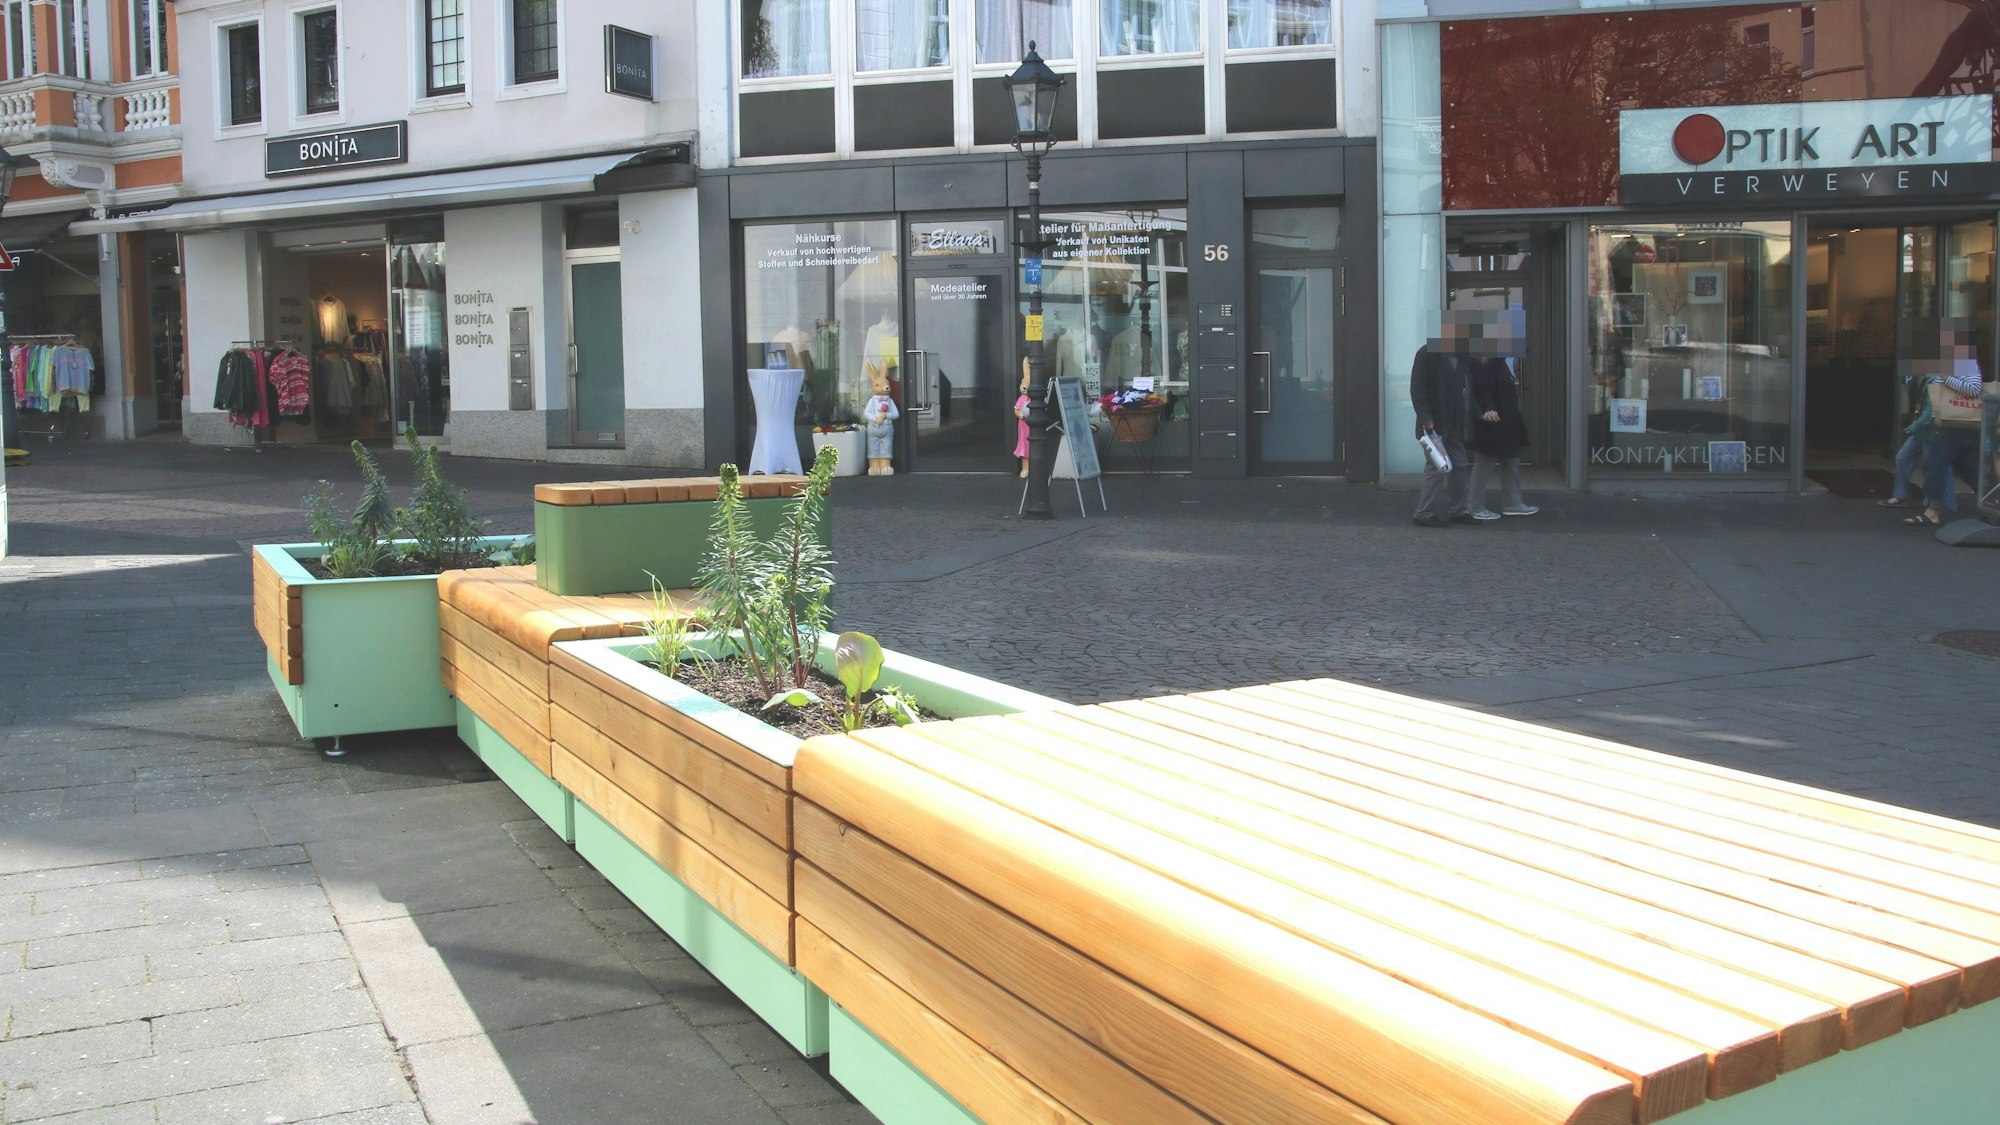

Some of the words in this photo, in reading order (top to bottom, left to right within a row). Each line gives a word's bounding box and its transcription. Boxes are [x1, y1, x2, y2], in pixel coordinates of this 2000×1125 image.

[1851, 121, 1945, 160] ART
[1676, 170, 1949, 195] VERWEYEN
[1039, 224, 1068, 234] telier
[1070, 222, 1087, 233] für
[1088, 219, 1172, 232] Maßanfertigung
[795, 233, 842, 243] Nähkurse
[929, 228, 983, 249] Ellara
[1056, 237, 1090, 246] Verkauf
[1091, 236, 1107, 245] von
[1109, 234, 1150, 244] Unikaten
[767, 248, 798, 257] Verkauf
[800, 248, 815, 256] von
[816, 245, 872, 257] hochwertigen
[1052, 250, 1068, 258] aus
[1070, 249, 1103, 259] eigener
[1105, 246, 1151, 256] Kollektion
[1203, 244, 1230, 262] 56
[758, 258, 787, 268] Stoffen
[789, 258, 804, 267] und
[805, 255, 880, 267] Schneidereibedarf
[931, 283, 987, 293] Modeatelier
